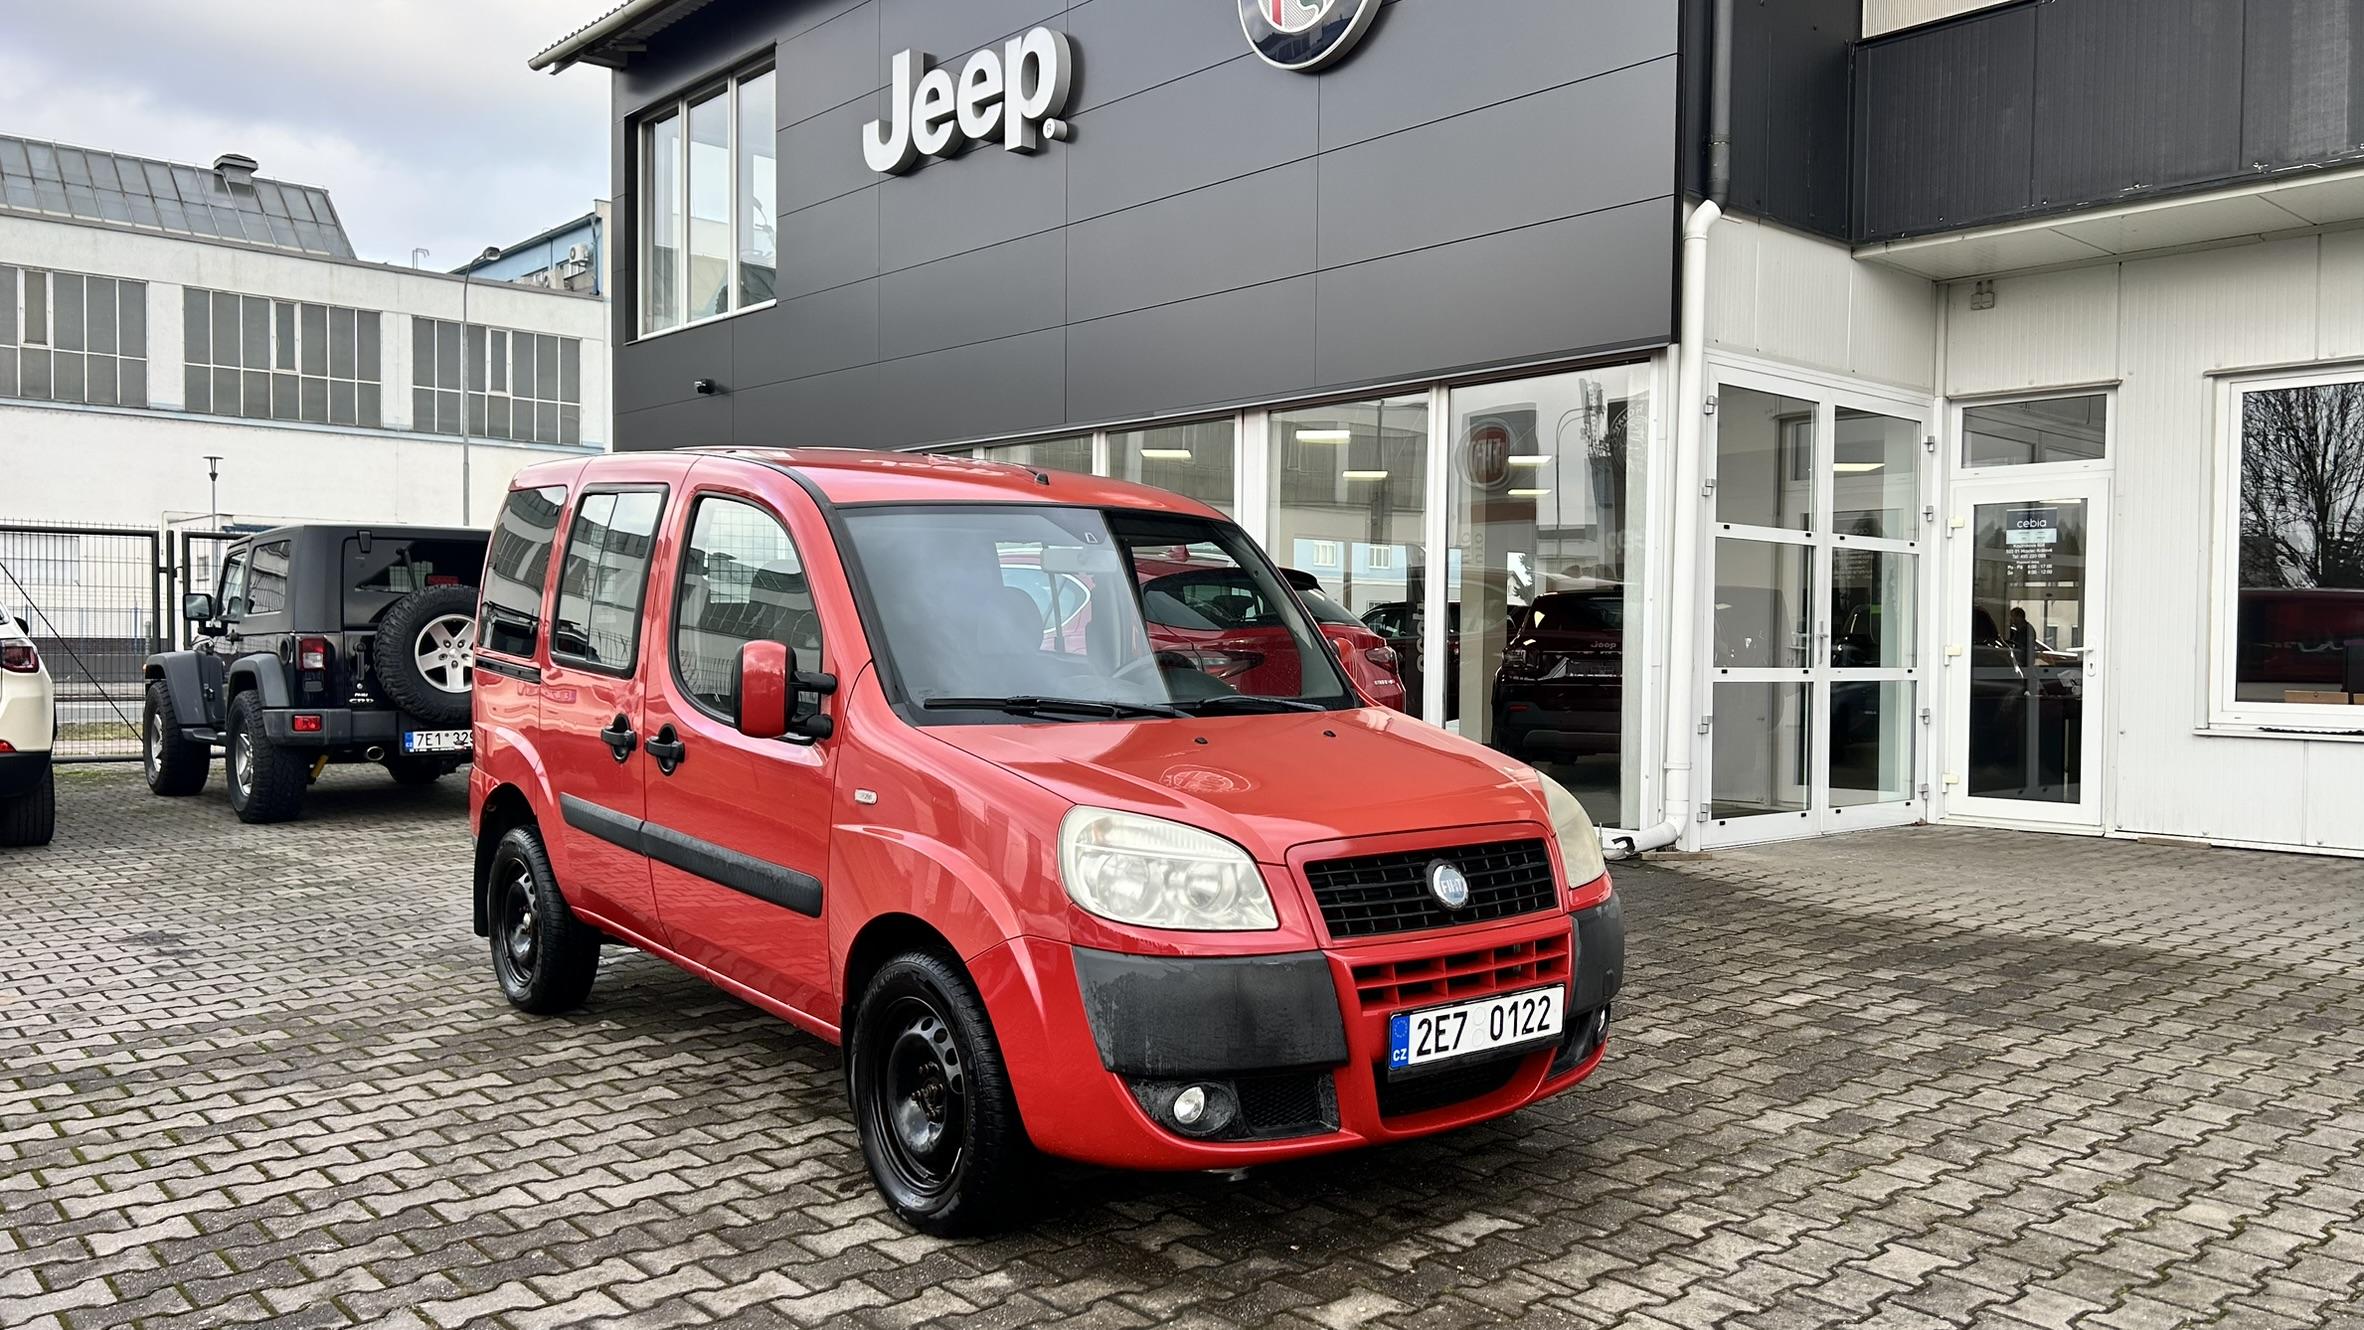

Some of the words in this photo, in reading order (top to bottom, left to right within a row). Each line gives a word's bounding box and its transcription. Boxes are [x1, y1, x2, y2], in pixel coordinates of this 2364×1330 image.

[863, 26, 1064, 172] Jeep
[417, 733, 441, 747] 7E1
[1416, 1011, 1468, 1057] 2E7
[1489, 995, 1551, 1041] 0122
[1393, 1048, 1407, 1062] CZ
